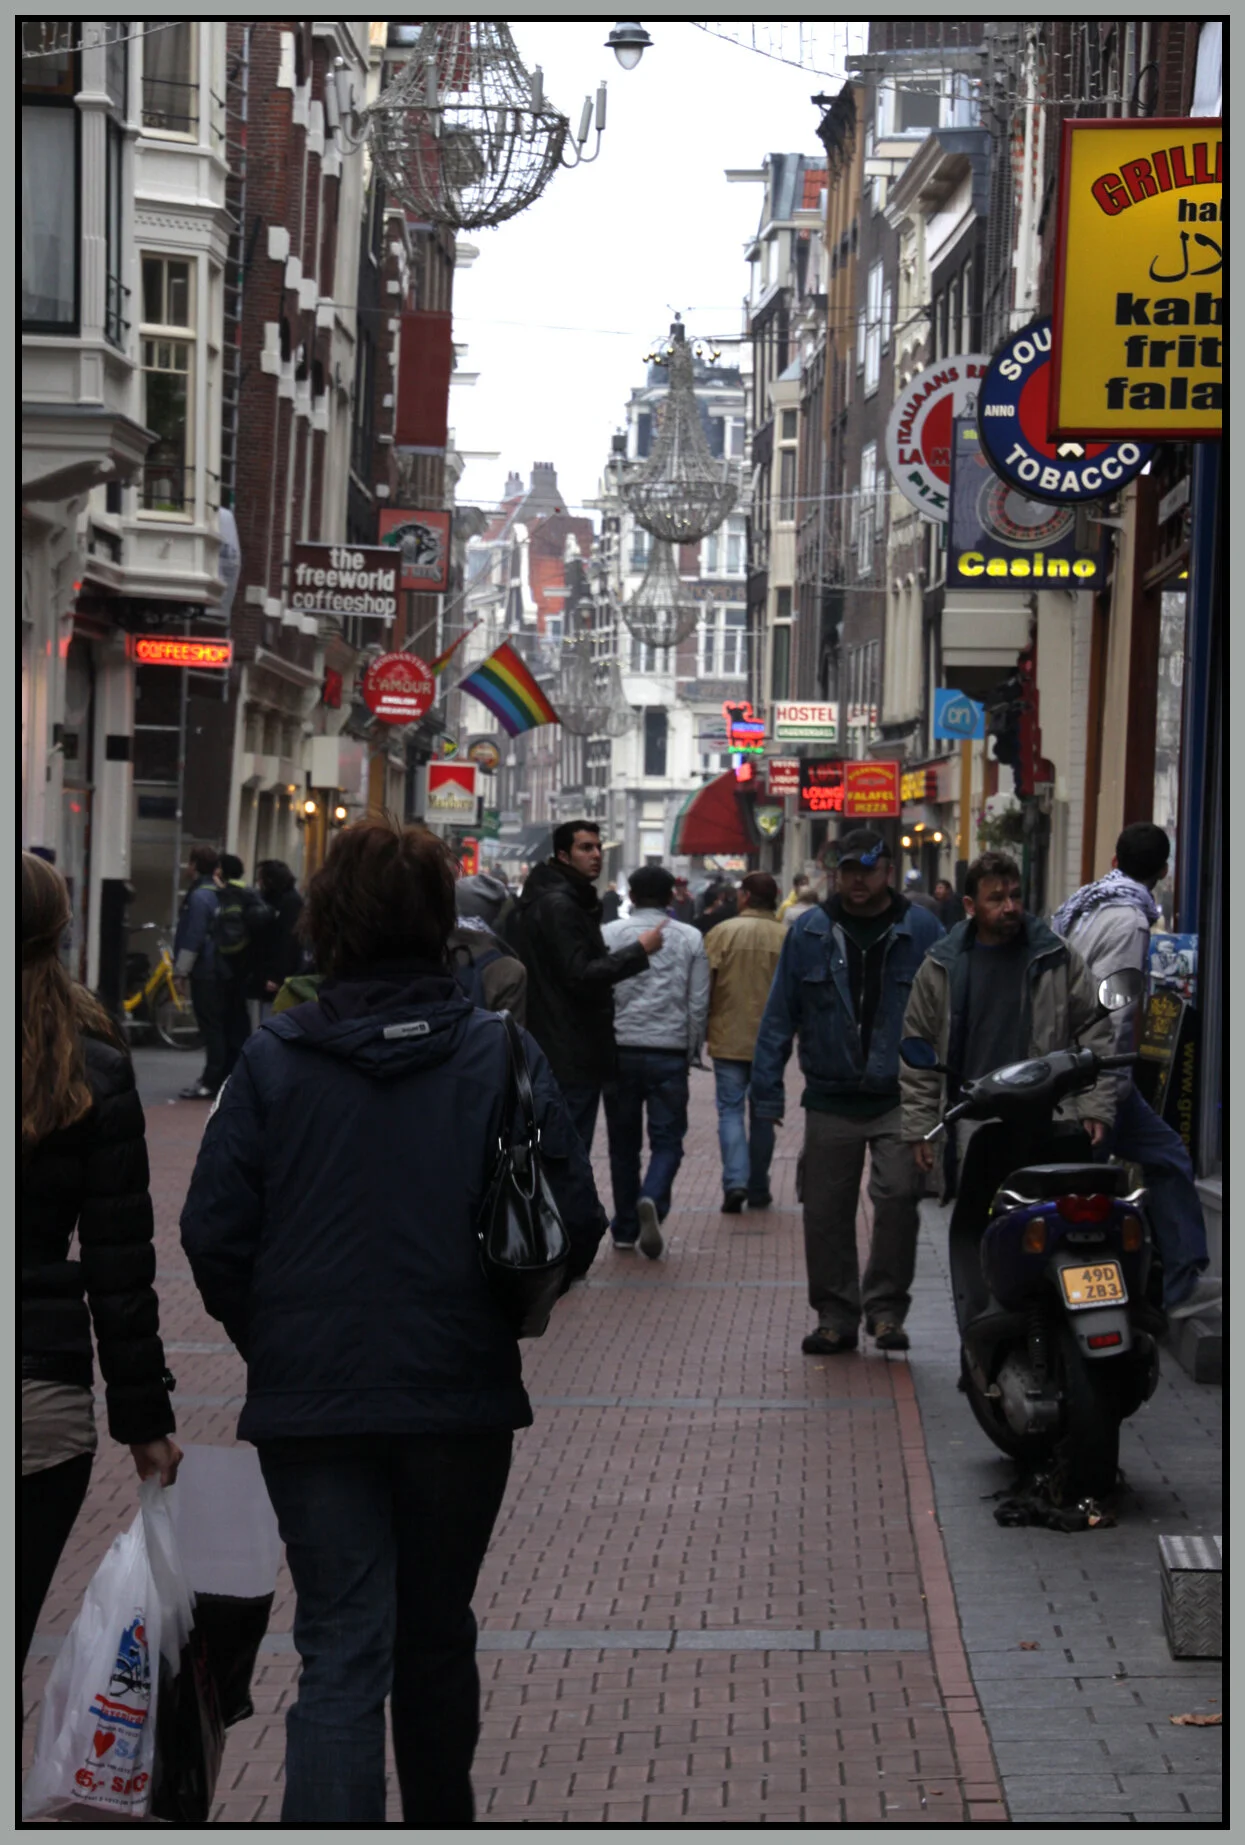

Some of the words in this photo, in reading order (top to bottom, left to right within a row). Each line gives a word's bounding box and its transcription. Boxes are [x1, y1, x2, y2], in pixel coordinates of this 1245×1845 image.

[1178, 199, 1222, 222] ha
[1105, 377, 1222, 410] fala
[897, 367, 960, 445] ITALIAANS
[984, 404, 1016, 418] ANNO
[898, 448, 923, 466] LA
[1005, 442, 1141, 494] TOBACCO
[329, 548, 366, 571] the
[957, 551, 1097, 578] Casino
[294, 563, 396, 592] freeworld
[291, 589, 397, 615] coffeeshop
[136, 640, 230, 662] COFFEESHOP
[367, 677, 432, 695] L'AMOUR
[776, 706, 837, 722] HOSTEL
[847, 791, 895, 801] FALAFEL
[854, 802, 889, 813] PIZZA
[1082, 1267, 1115, 1283] 49D
[1085, 1283, 1119, 1300] ZB3
